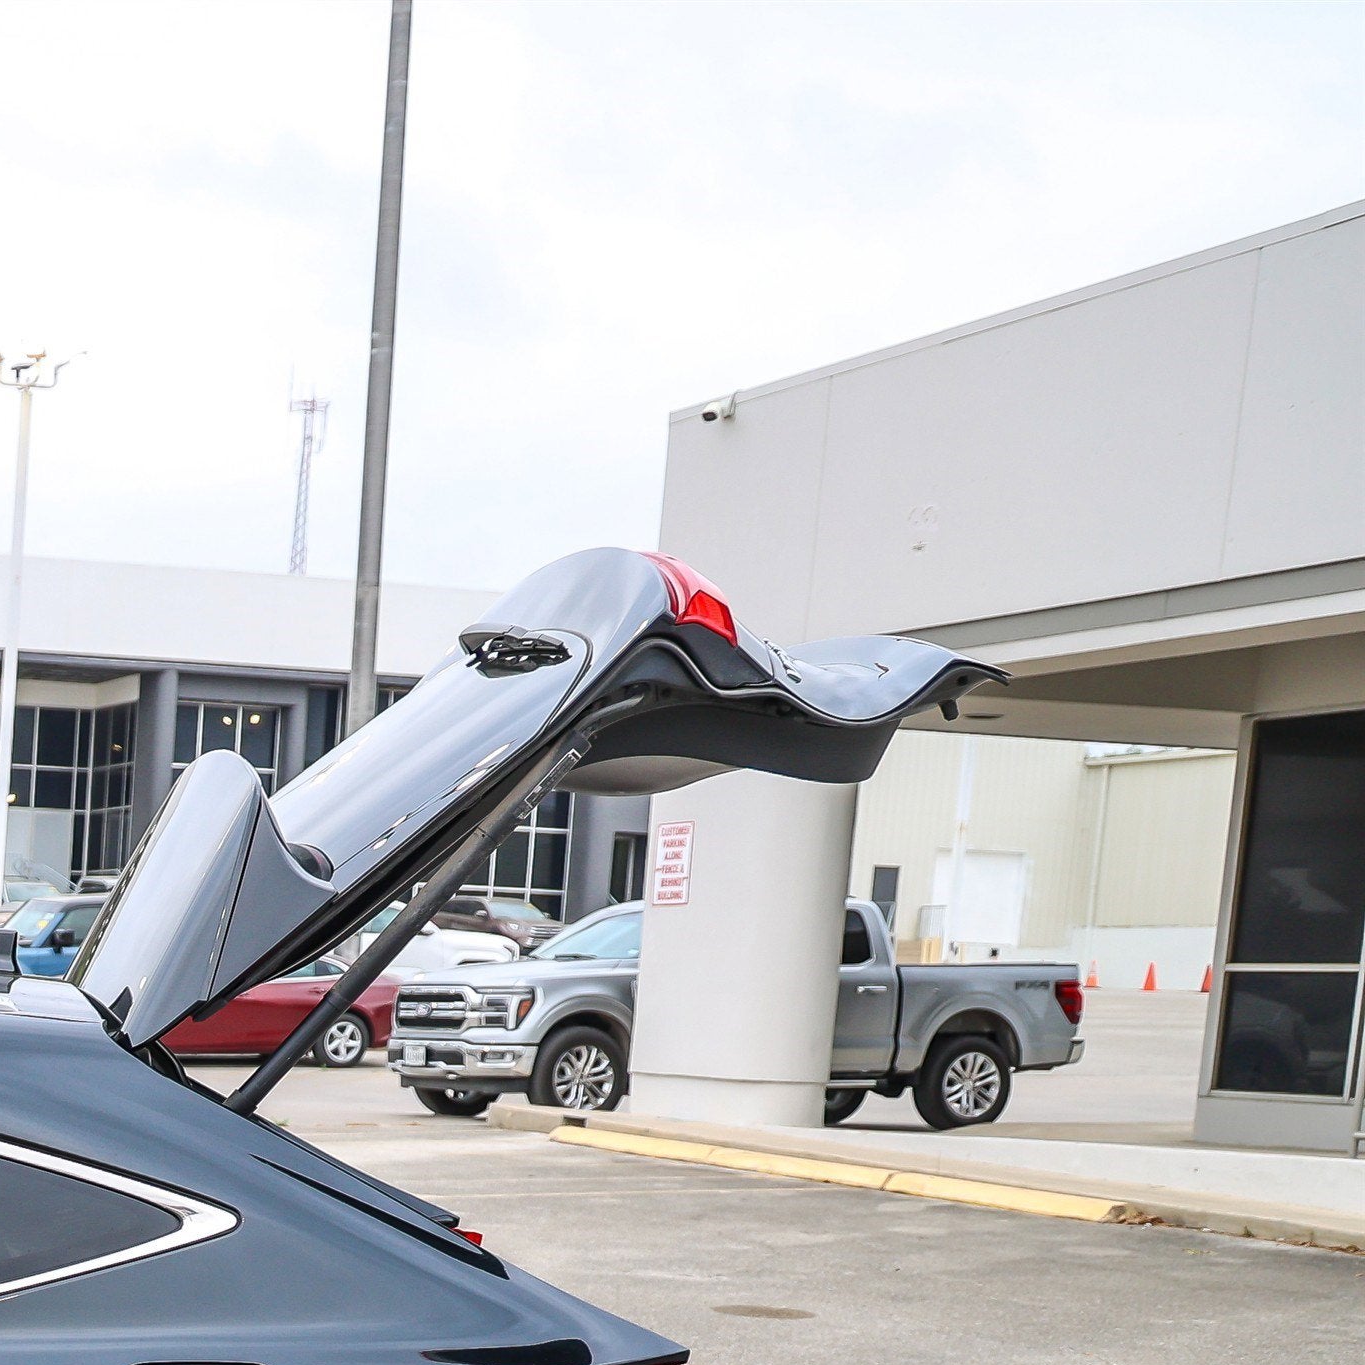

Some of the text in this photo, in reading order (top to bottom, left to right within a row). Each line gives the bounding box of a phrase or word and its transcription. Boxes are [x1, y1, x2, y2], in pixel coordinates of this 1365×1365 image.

[661, 825, 690, 837] CUSTOMER
[663, 838, 687, 848] PARKING
[664, 850, 683, 860] ALONG
